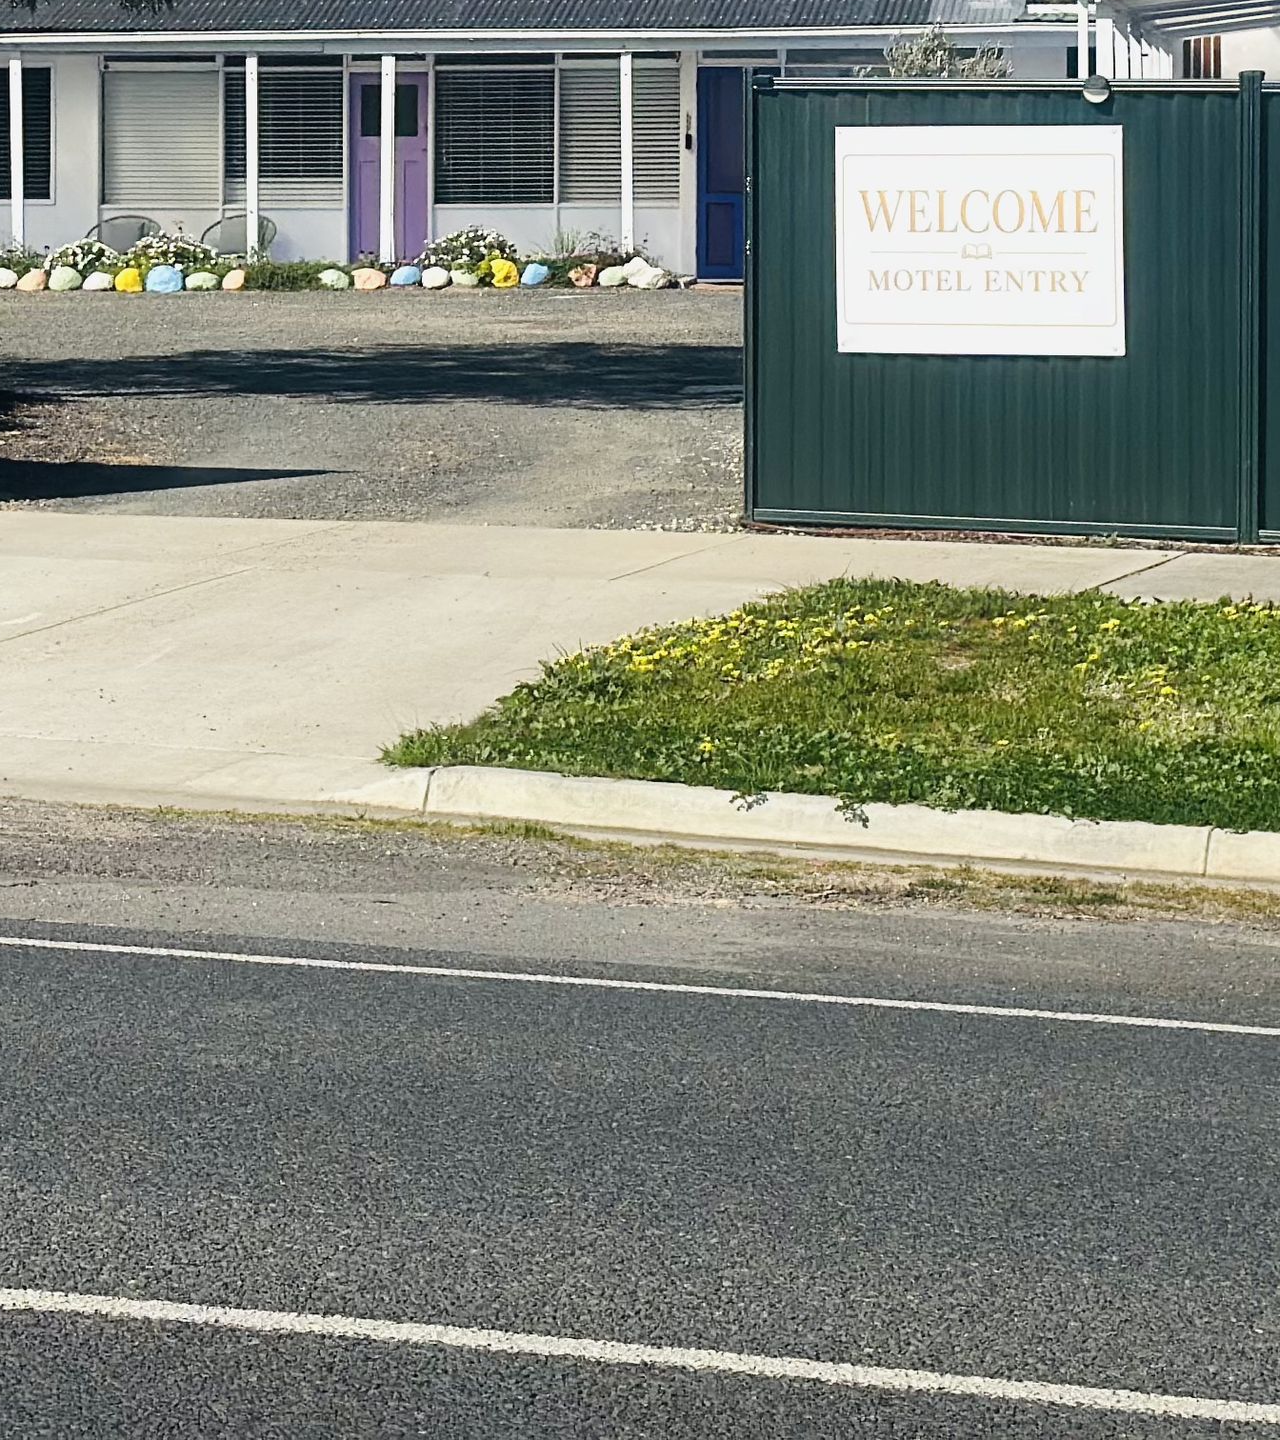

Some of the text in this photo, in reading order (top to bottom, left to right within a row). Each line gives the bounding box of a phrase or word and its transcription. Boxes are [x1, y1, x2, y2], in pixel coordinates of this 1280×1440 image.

[858, 189, 1098, 234] WELCOME
[868, 270, 1090, 293] MOTEL ENTRY
